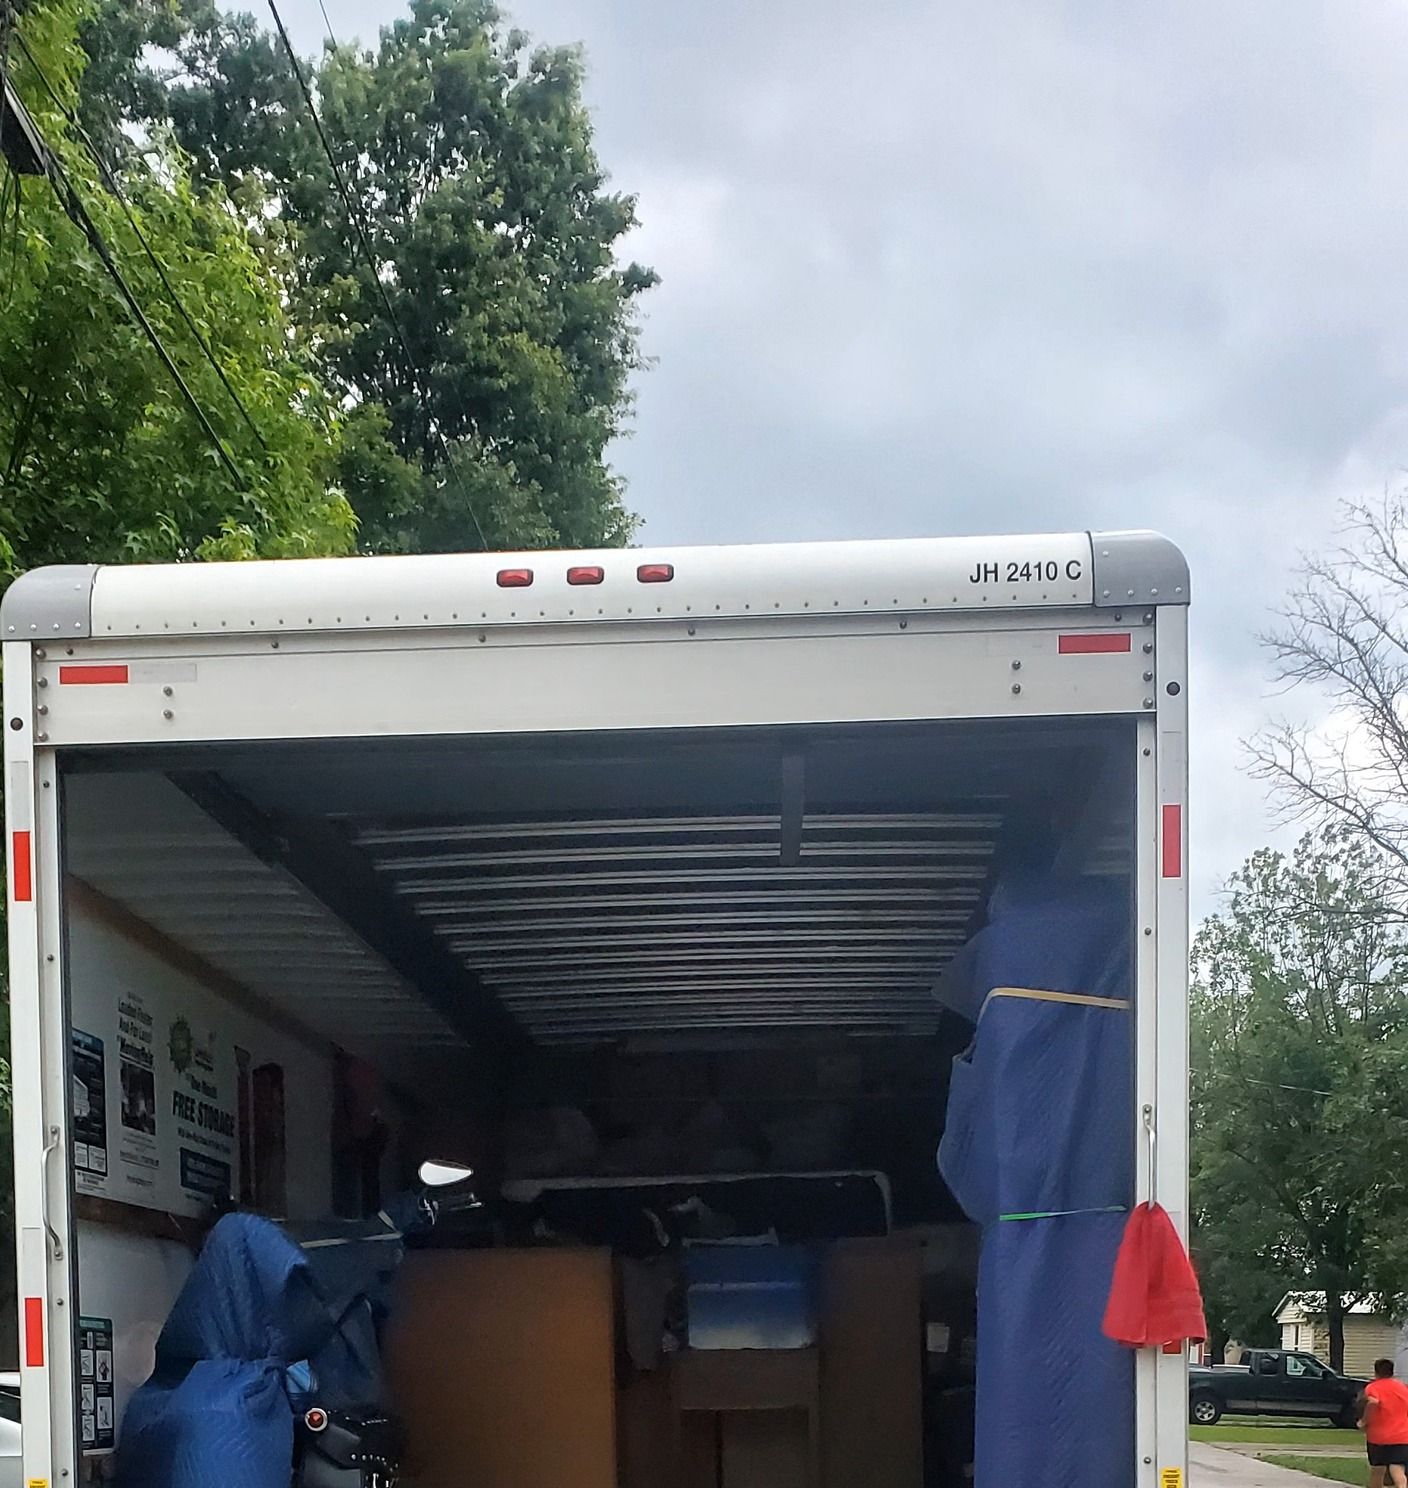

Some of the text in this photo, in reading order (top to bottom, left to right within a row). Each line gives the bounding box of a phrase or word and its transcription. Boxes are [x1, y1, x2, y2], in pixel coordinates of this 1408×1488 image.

[970, 560, 1082, 584] JH 2410 C
[172, 1090, 235, 1137] FREE STORAGE
